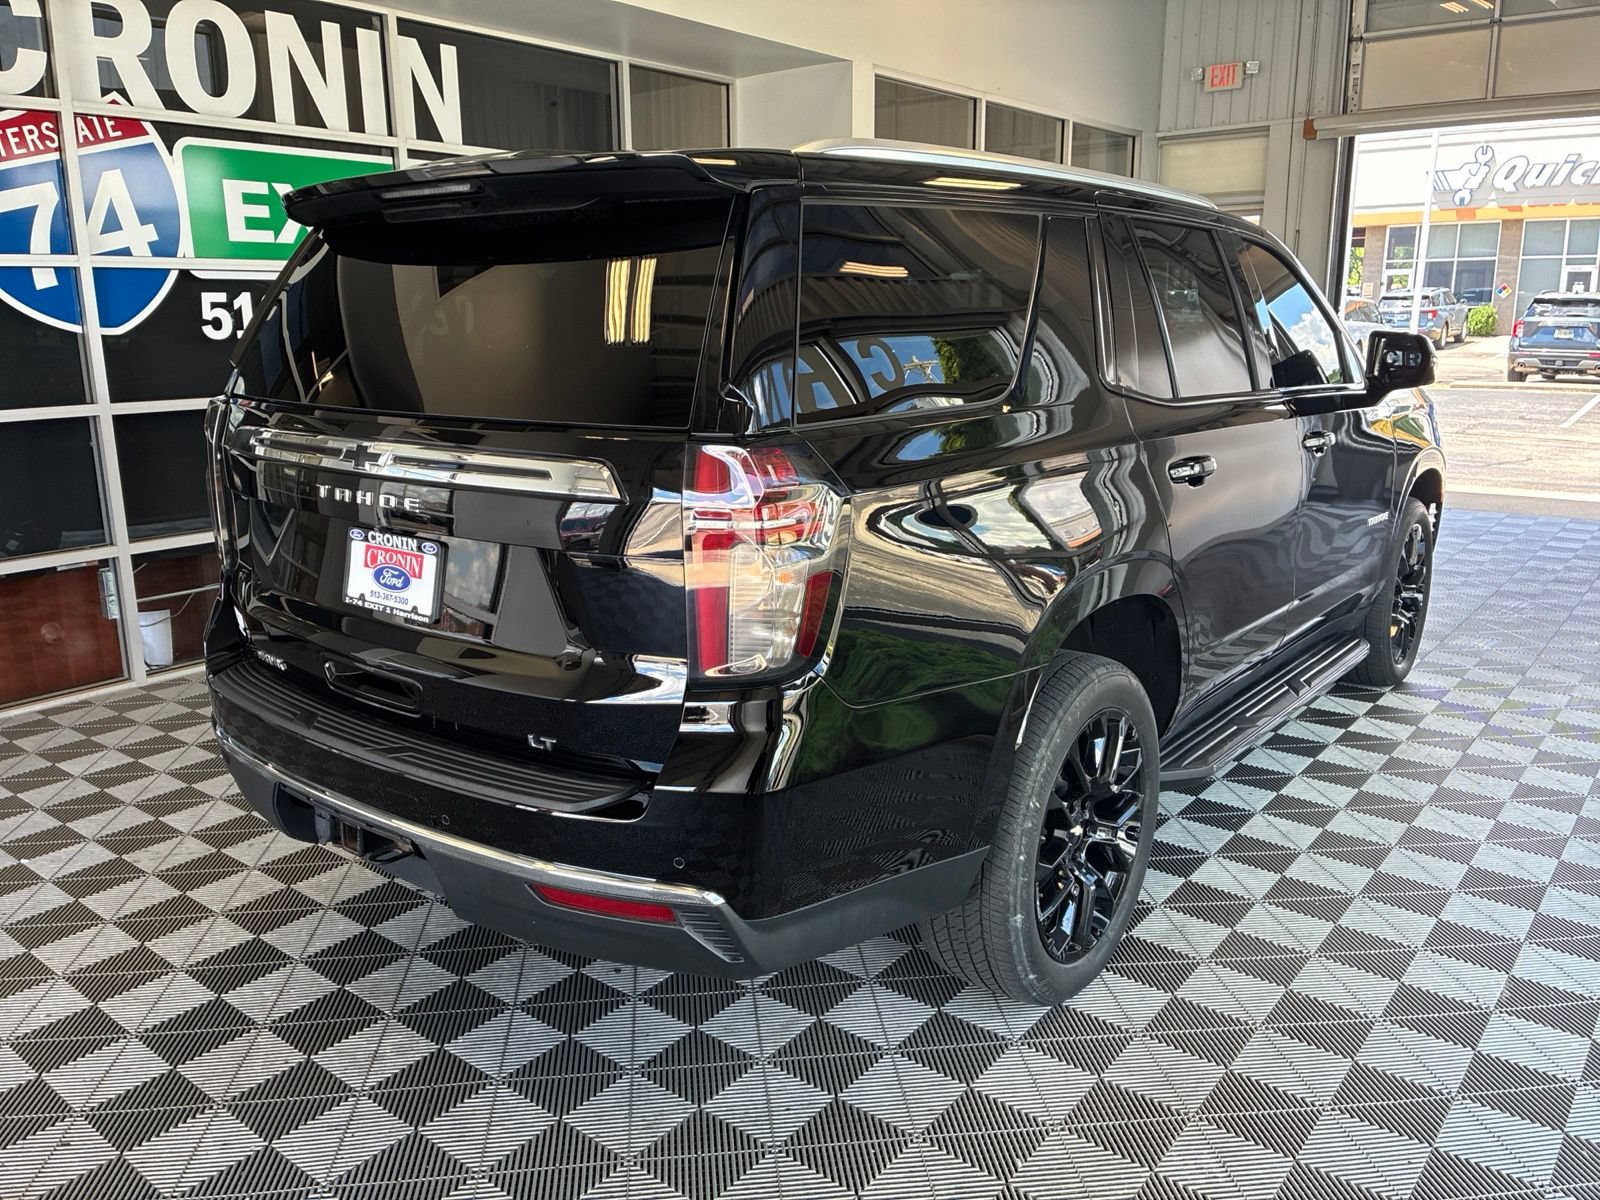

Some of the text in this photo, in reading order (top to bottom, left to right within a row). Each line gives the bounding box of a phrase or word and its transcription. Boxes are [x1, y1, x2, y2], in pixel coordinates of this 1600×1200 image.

[1210, 63, 1238, 87] EXIT
[1492, 153, 1600, 192] Quic
[0, 168, 159, 290] 74
[316, 483, 421, 513] TAHOE
[367, 530, 418, 552] CRONIN
[366, 548, 422, 579] CRONIN
[379, 567, 406, 588] Ford
[345, 596, 430, 623] I-74 EXIT 1 Harrison
[527, 734, 557, 751] LT
